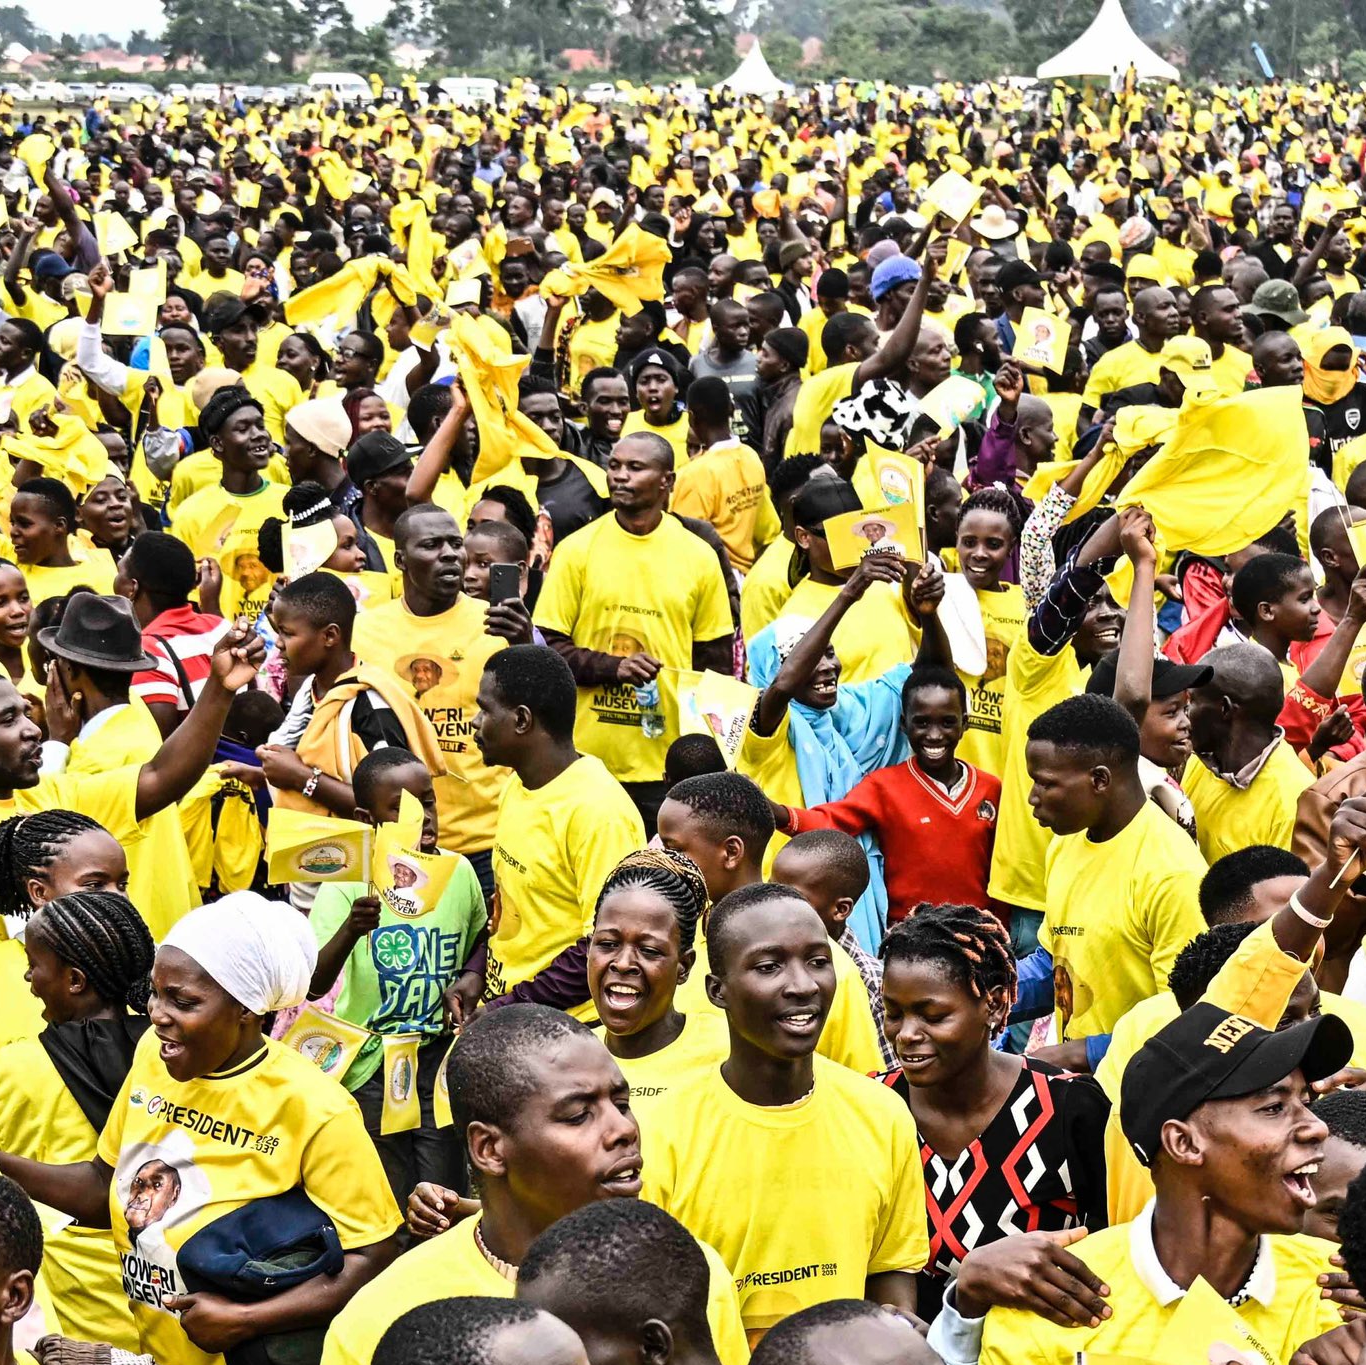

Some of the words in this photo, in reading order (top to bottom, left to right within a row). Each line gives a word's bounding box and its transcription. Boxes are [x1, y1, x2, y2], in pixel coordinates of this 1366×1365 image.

[619, 605, 655, 616] PRESIDENT
[594, 696, 641, 711] MUSEV
[424, 707, 463, 723] WERI
[159, 1101, 256, 1150] PRESIDENT
[120, 1250, 177, 1294] YOWERI
[744, 1264, 820, 1288] PRESIDENT
